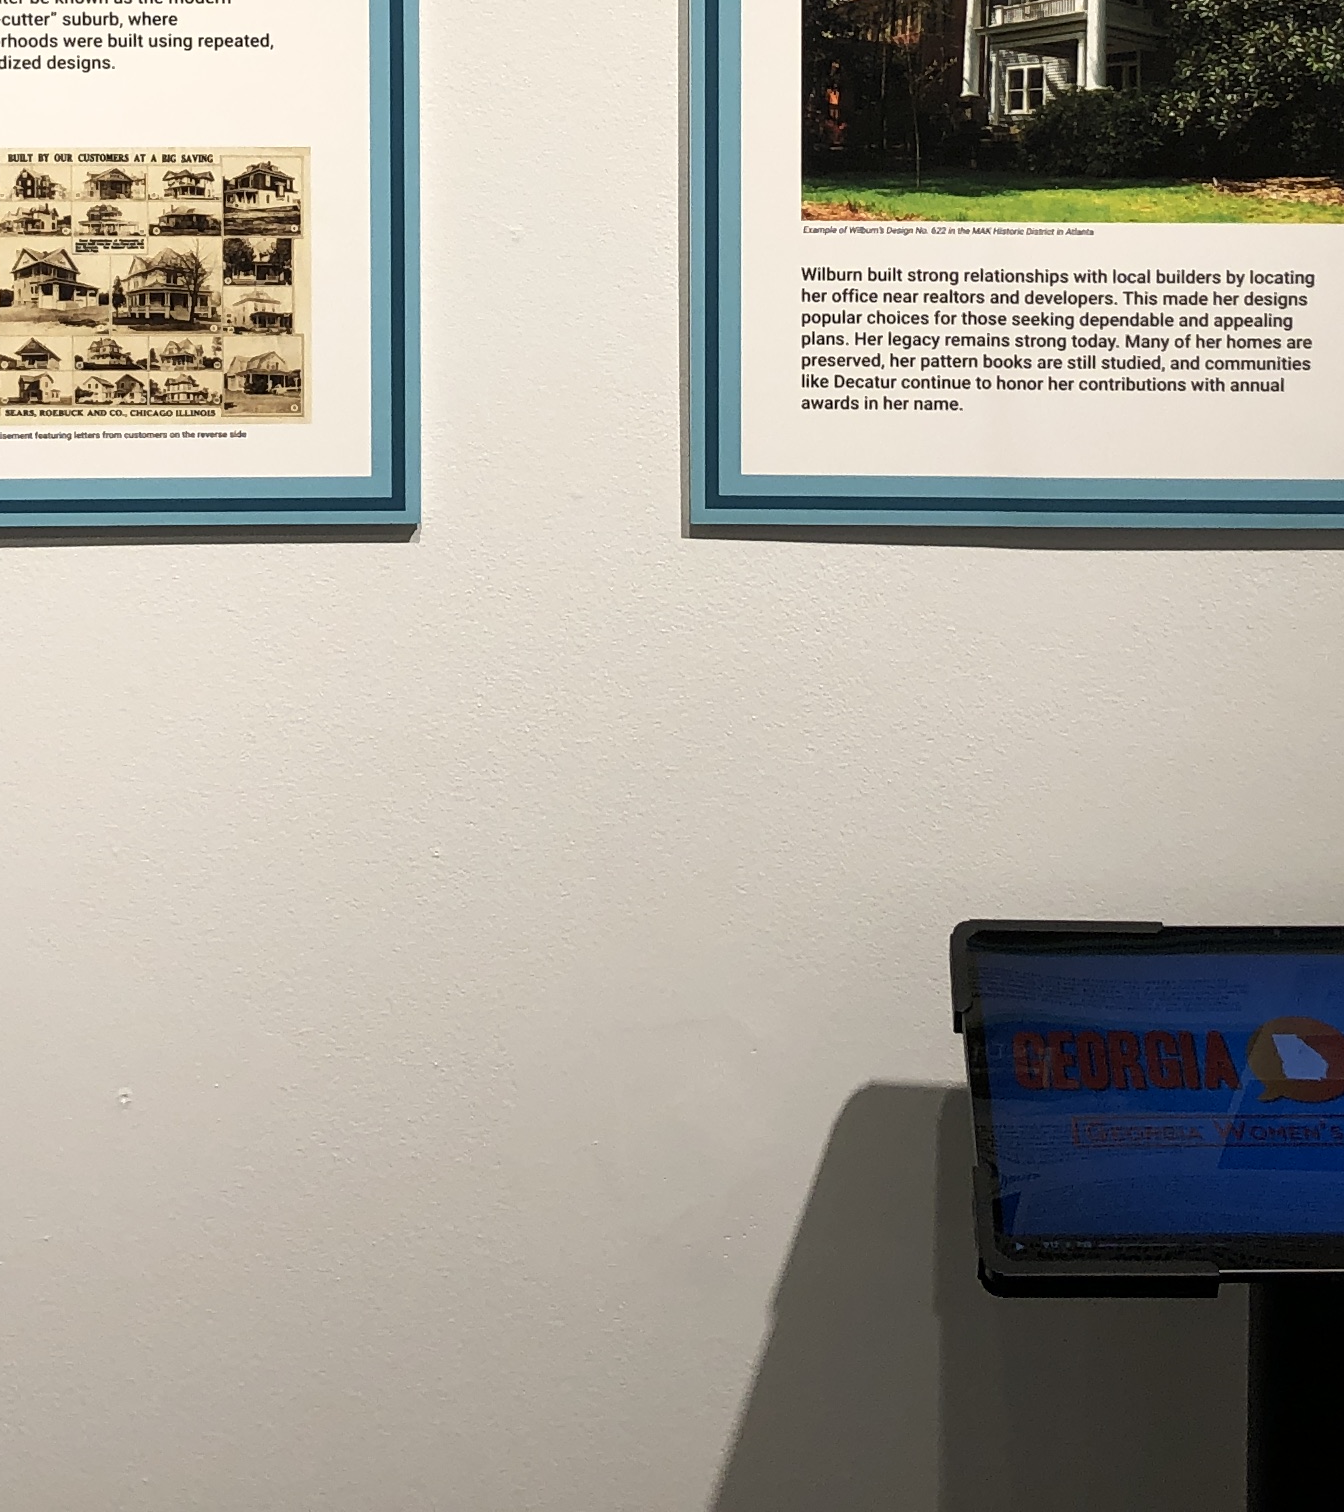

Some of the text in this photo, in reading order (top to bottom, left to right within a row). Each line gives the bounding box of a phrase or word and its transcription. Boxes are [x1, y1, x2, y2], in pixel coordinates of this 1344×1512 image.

[8, 153, 213, 163] BUILT BY OUR CUSTOMERS AT A BIG SAVING
[803, 226, 837, 235] Example
[839, 226, 848, 234] of
[886, 226, 914, 236] Design
[957, 227, 971, 235] the
[972, 227, 992, 235] MAK
[993, 227, 1024, 235] Historic
[1065, 228, 1094, 236] Atlanta
[801, 395, 963, 411] awards in her name.
[5, 409, 37, 417] SEARS,
[39, 409, 84, 417] ROEBUCK
[35, 431, 72, 441] featuring
[74, 431, 100, 439] letters
[102, 431, 122, 439] from
[230, 430, 247, 438] side
[1013, 1030, 1242, 1091] GEORGIA
